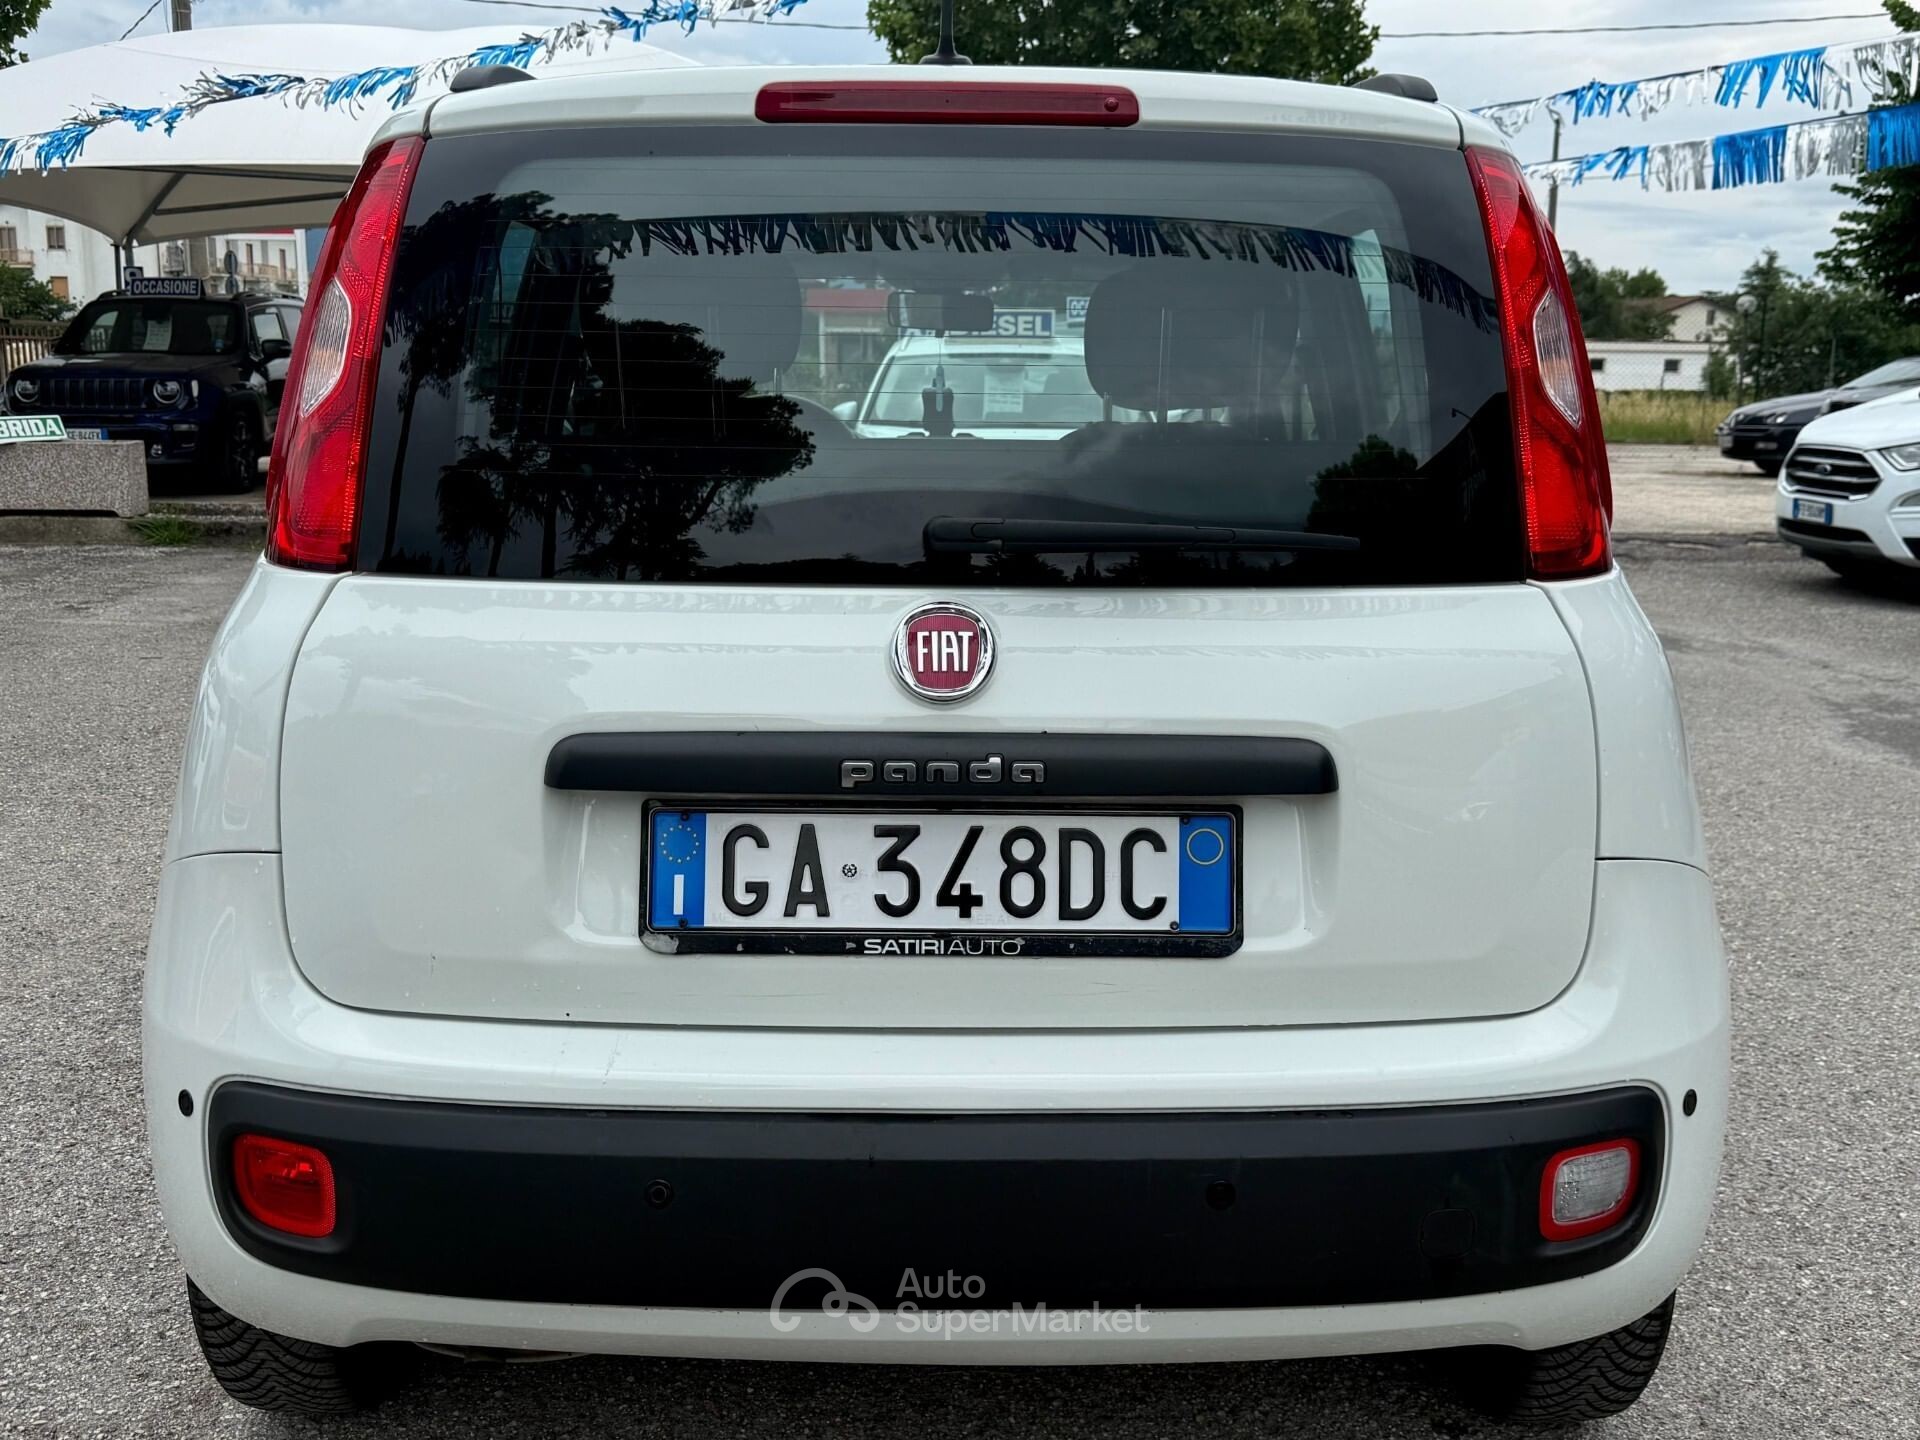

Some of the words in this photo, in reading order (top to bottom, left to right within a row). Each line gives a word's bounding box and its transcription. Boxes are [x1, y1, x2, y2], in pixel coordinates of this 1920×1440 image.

[133, 280, 197, 294] OCCASIONE
[917, 631, 974, 673] FIAT
[841, 756, 1044, 788] panda
[673, 874, 684, 915] I
[722, 824, 831, 918] GA
[873, 825, 1168, 921] 348DC
